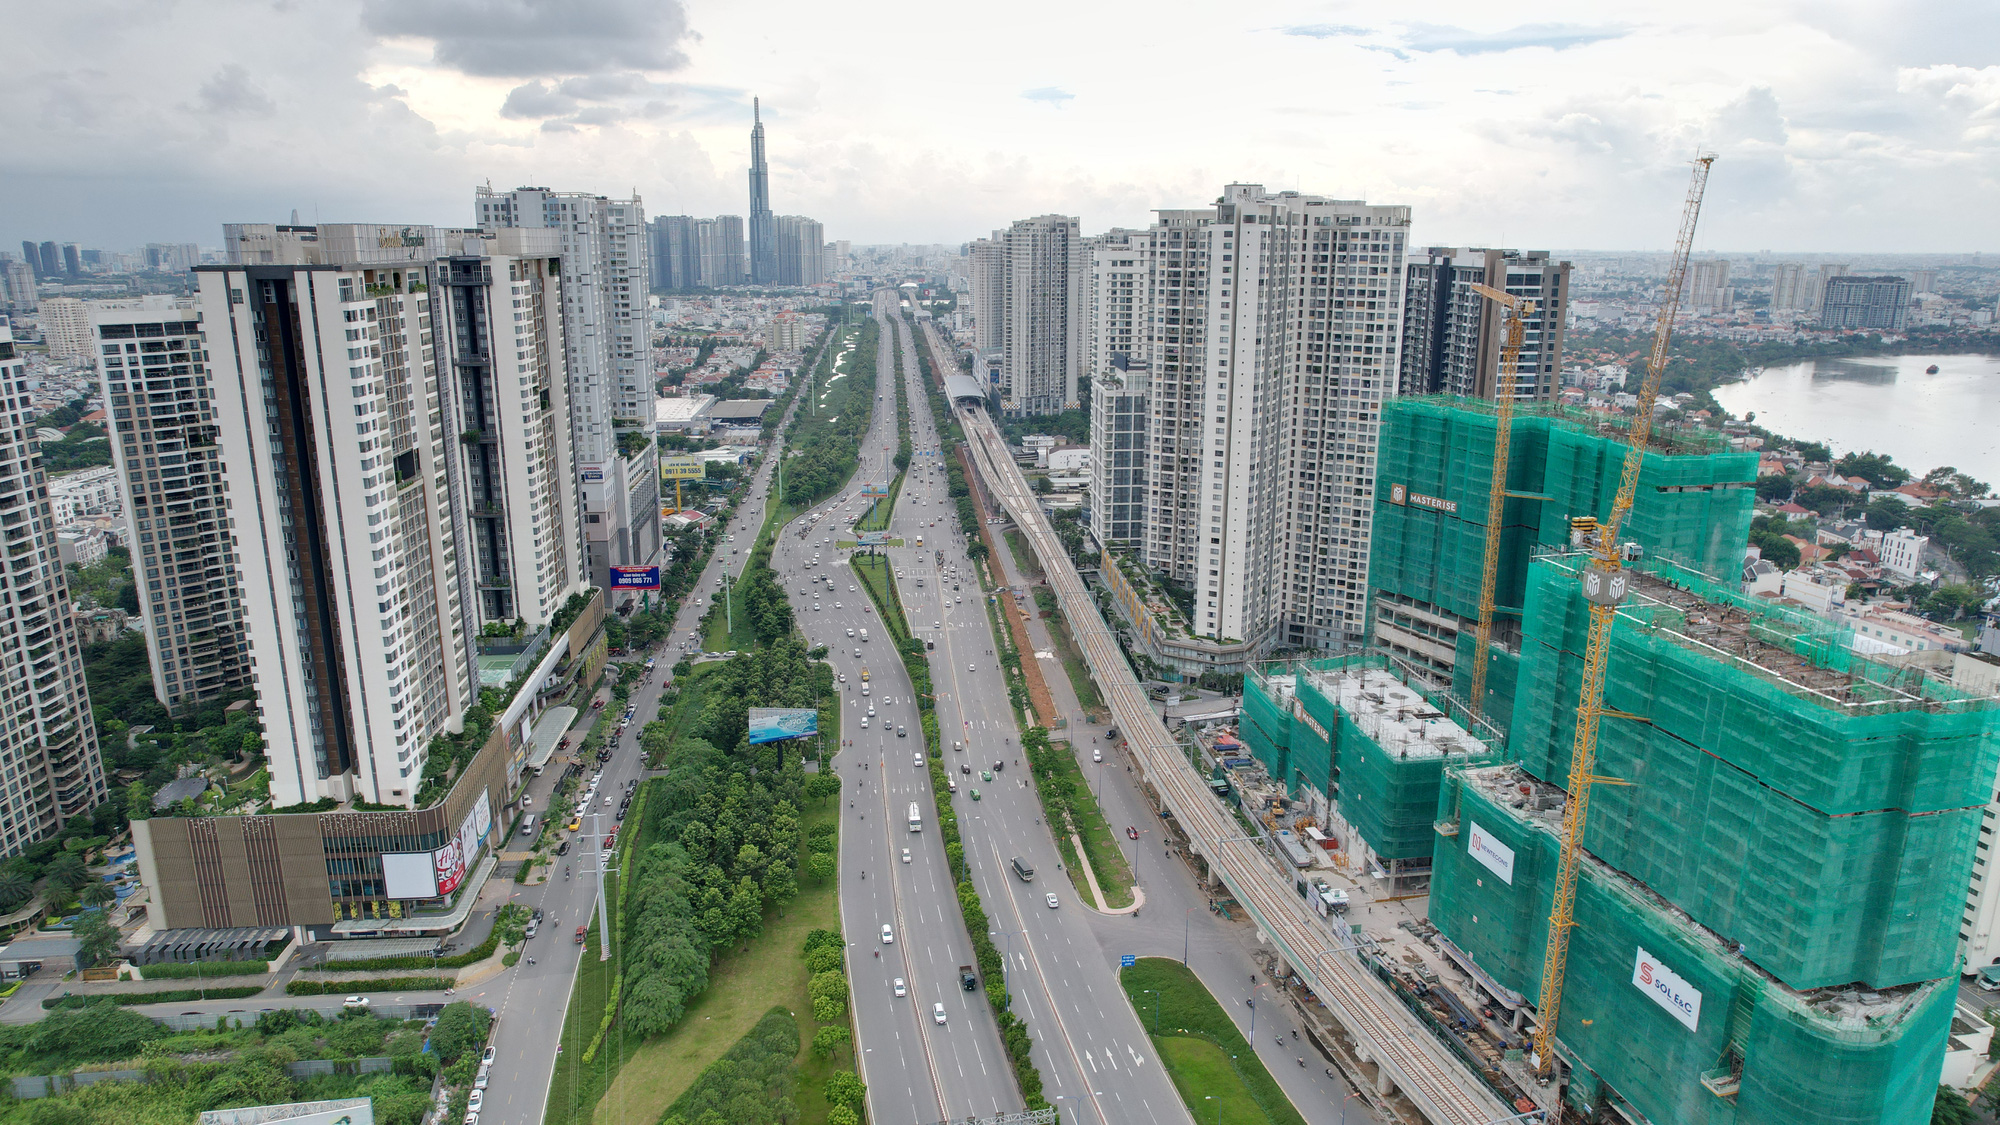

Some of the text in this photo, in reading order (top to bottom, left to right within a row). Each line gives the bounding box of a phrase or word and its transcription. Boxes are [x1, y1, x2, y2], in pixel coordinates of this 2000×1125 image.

[1410, 494, 1456, 511] MASTERISE
[1481, 843, 1508, 868] NEWTECONS
[1655, 979, 1672, 999] SOL
[1674, 994, 1692, 1013] E&C
